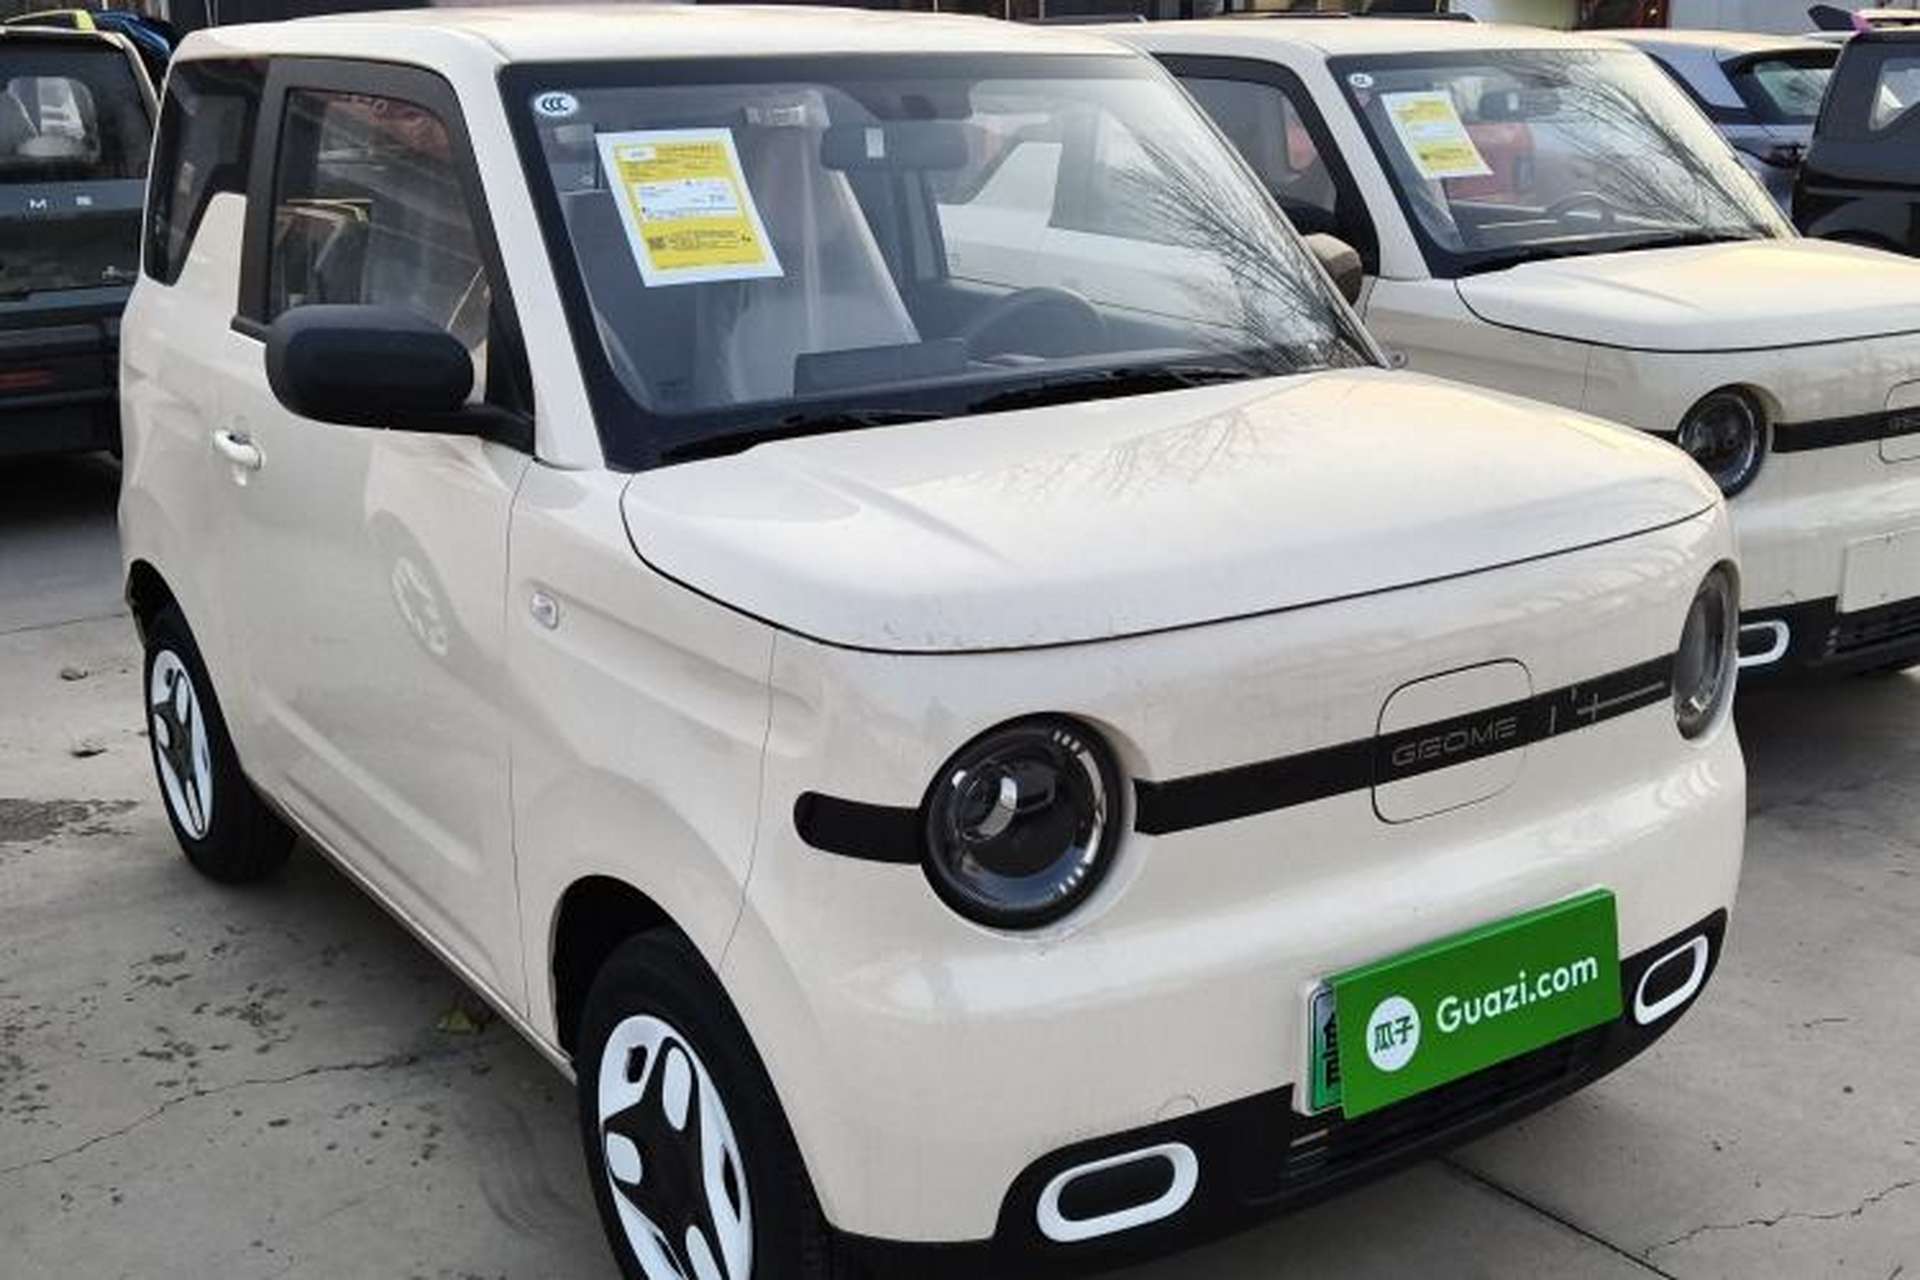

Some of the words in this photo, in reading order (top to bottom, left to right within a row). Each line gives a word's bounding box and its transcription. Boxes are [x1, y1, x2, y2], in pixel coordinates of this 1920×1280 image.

[1392, 716, 1517, 767] GEOME
[1373, 1015, 1414, 1054] 瓜子
[1435, 955, 1599, 1034] Guazi.com
